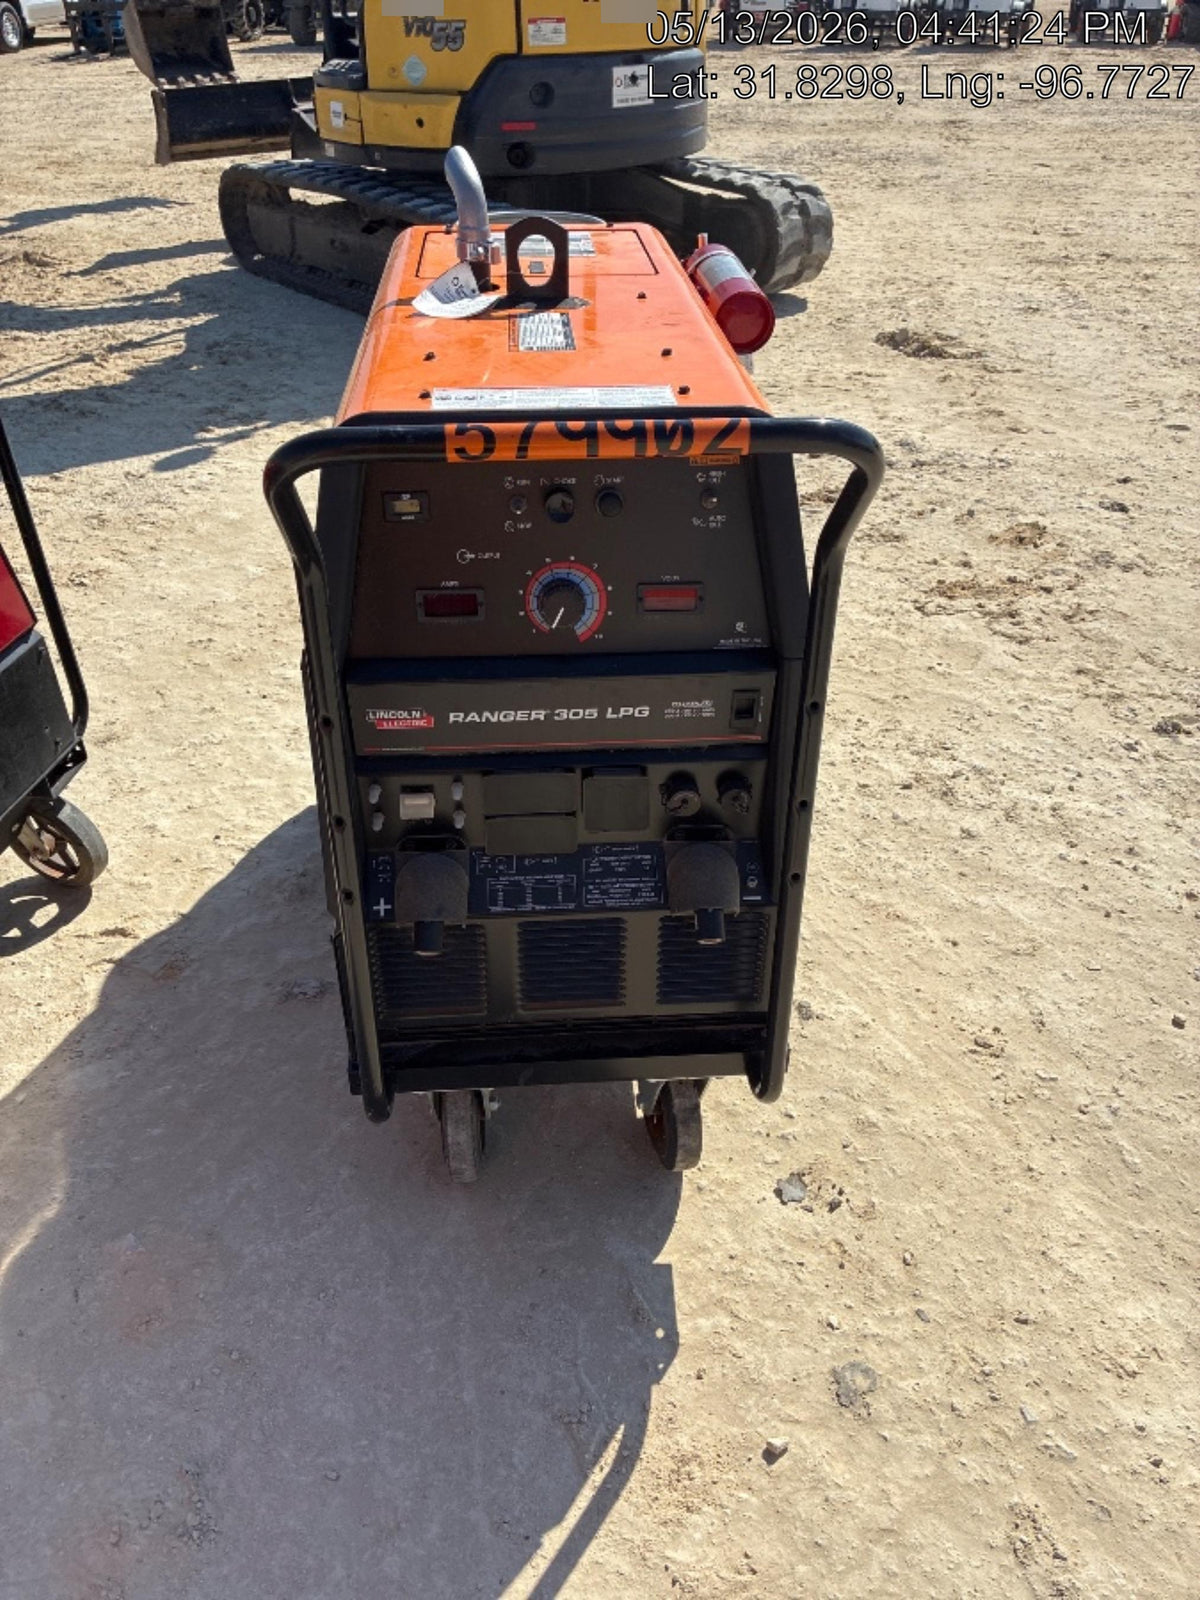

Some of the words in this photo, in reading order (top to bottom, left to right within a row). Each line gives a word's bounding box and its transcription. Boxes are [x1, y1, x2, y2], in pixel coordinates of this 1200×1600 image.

[368, 709, 421, 719] LINCOLN
[448, 710, 545, 724] RANGER
[553, 708, 599, 721] 305
[605, 706, 650, 720] LPG
